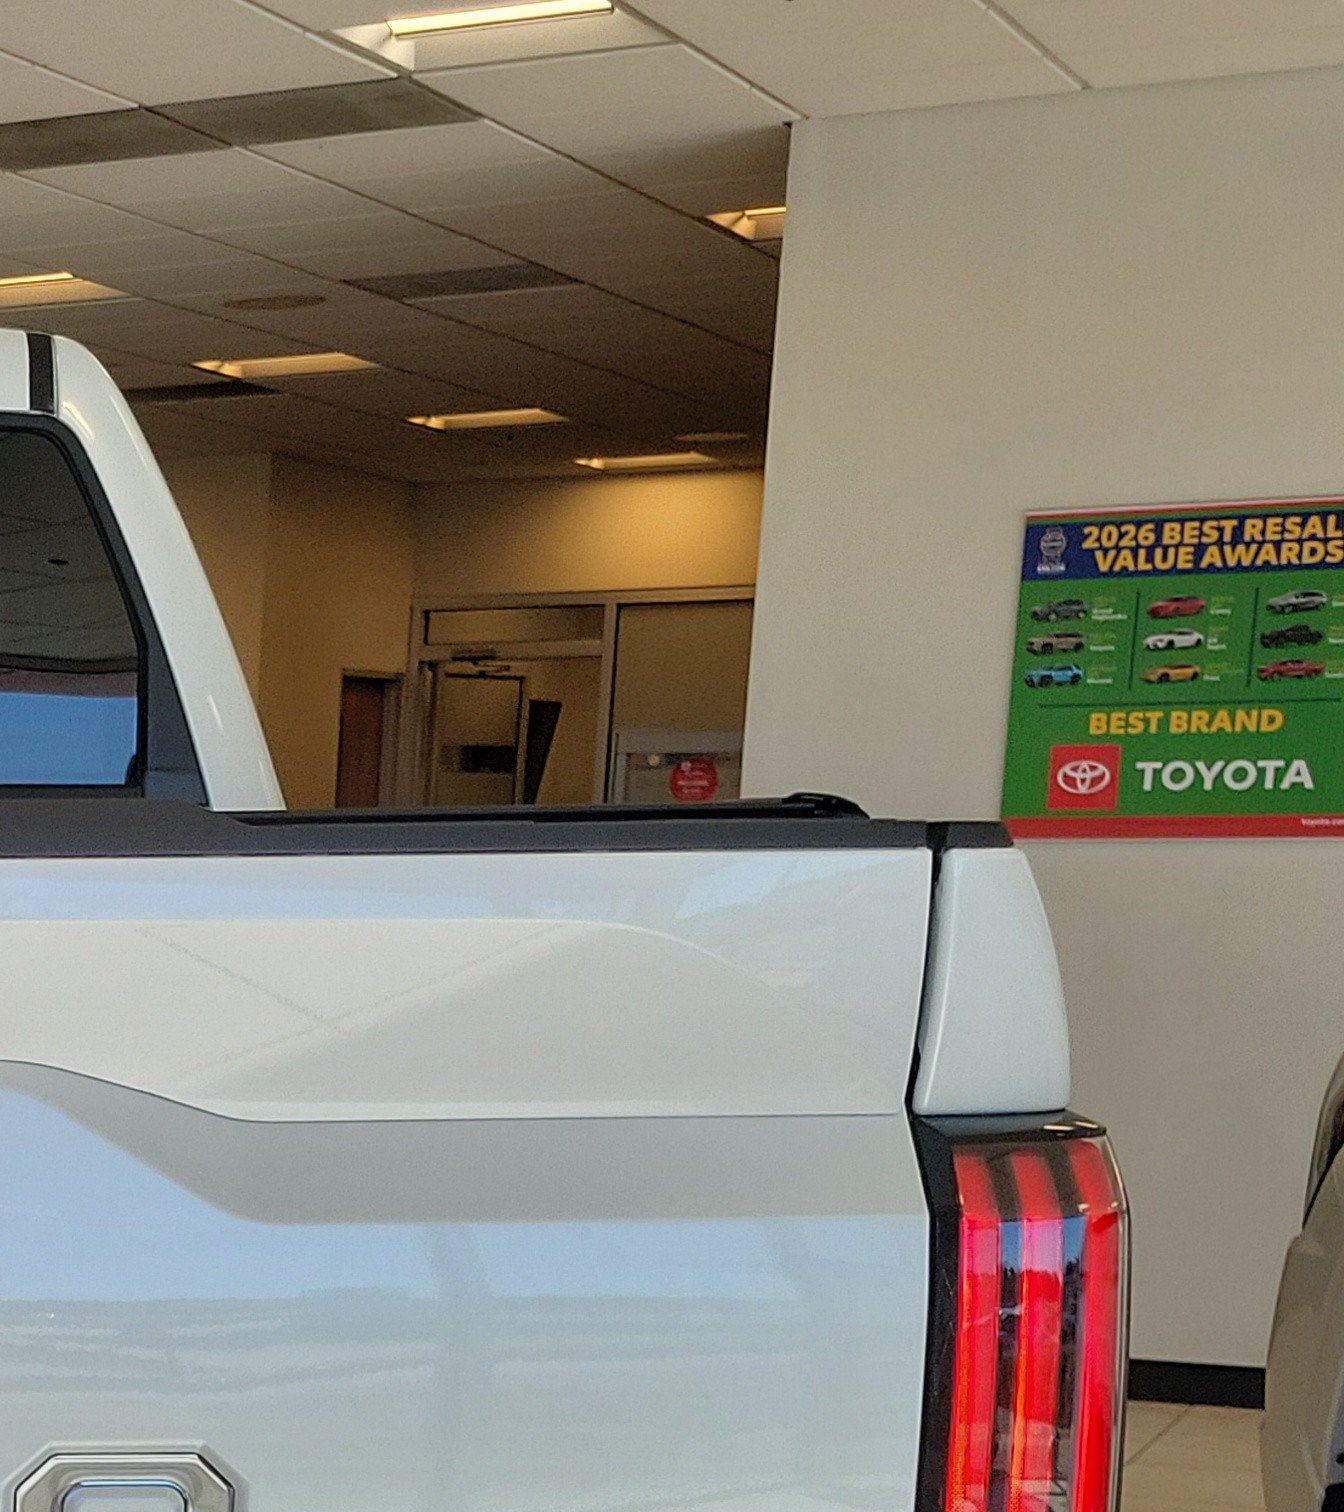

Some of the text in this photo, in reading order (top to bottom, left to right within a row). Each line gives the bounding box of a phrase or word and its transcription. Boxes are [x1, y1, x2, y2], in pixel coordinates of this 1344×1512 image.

[1081, 524, 1156, 550] 2026
[1162, 518, 1238, 546] BEST
[1094, 545, 1196, 573] VALUE
[1200, 539, 1344, 569] AWARDS
[1088, 708, 1285, 735] BEST BRAND
[1134, 759, 1315, 792] TOYOTA
